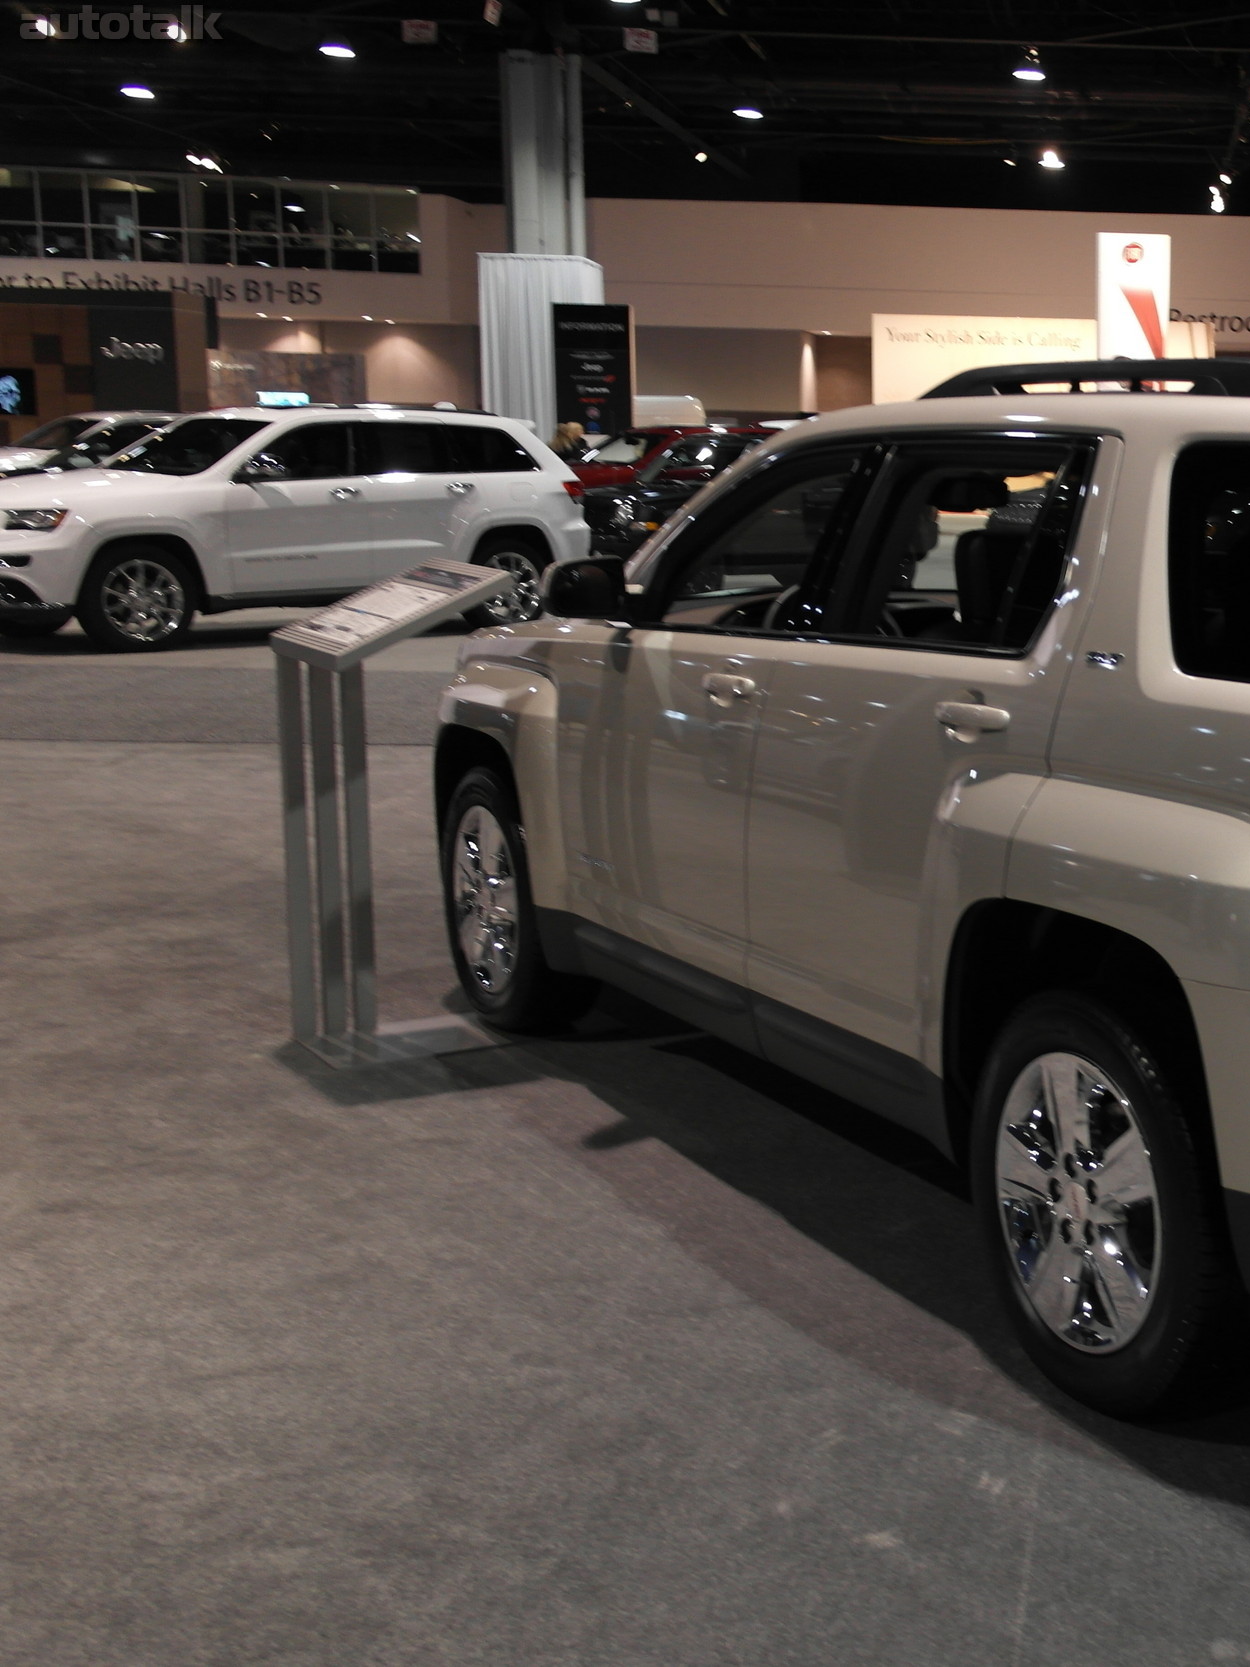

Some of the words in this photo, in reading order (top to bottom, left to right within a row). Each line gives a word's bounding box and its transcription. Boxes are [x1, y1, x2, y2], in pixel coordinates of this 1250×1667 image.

[168, 275, 236, 302] Halls
[244, 279, 322, 305] B1-B5
[100, 336, 164, 364] Jeep
